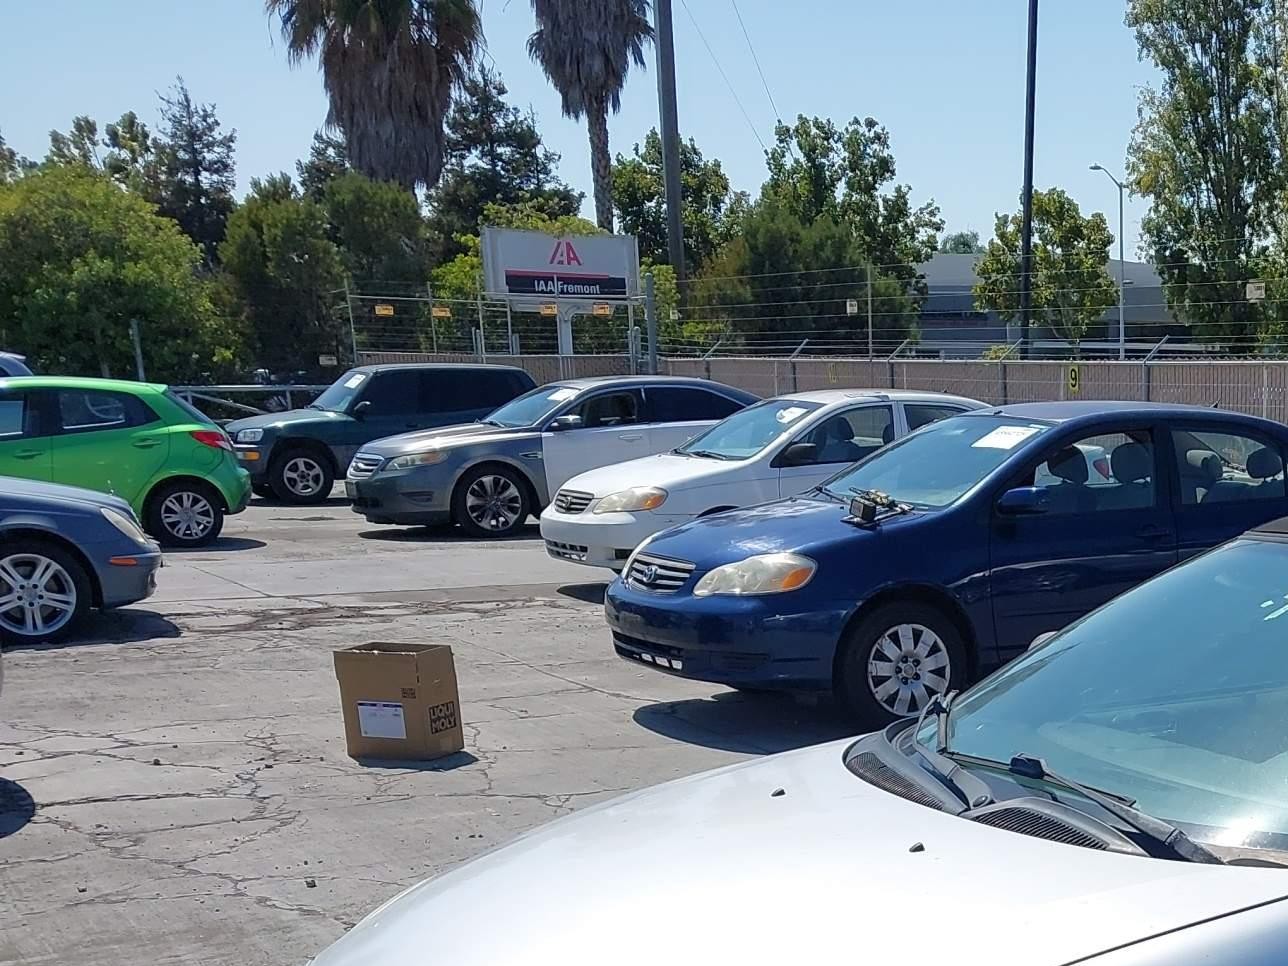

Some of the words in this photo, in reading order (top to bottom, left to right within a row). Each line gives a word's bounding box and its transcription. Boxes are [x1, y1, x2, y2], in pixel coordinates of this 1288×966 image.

[534, 279, 555, 292] IAA
[557, 281, 600, 294] Fremont
[1070, 368, 1078, 388] 9
[431, 715, 456, 733] MOLY
